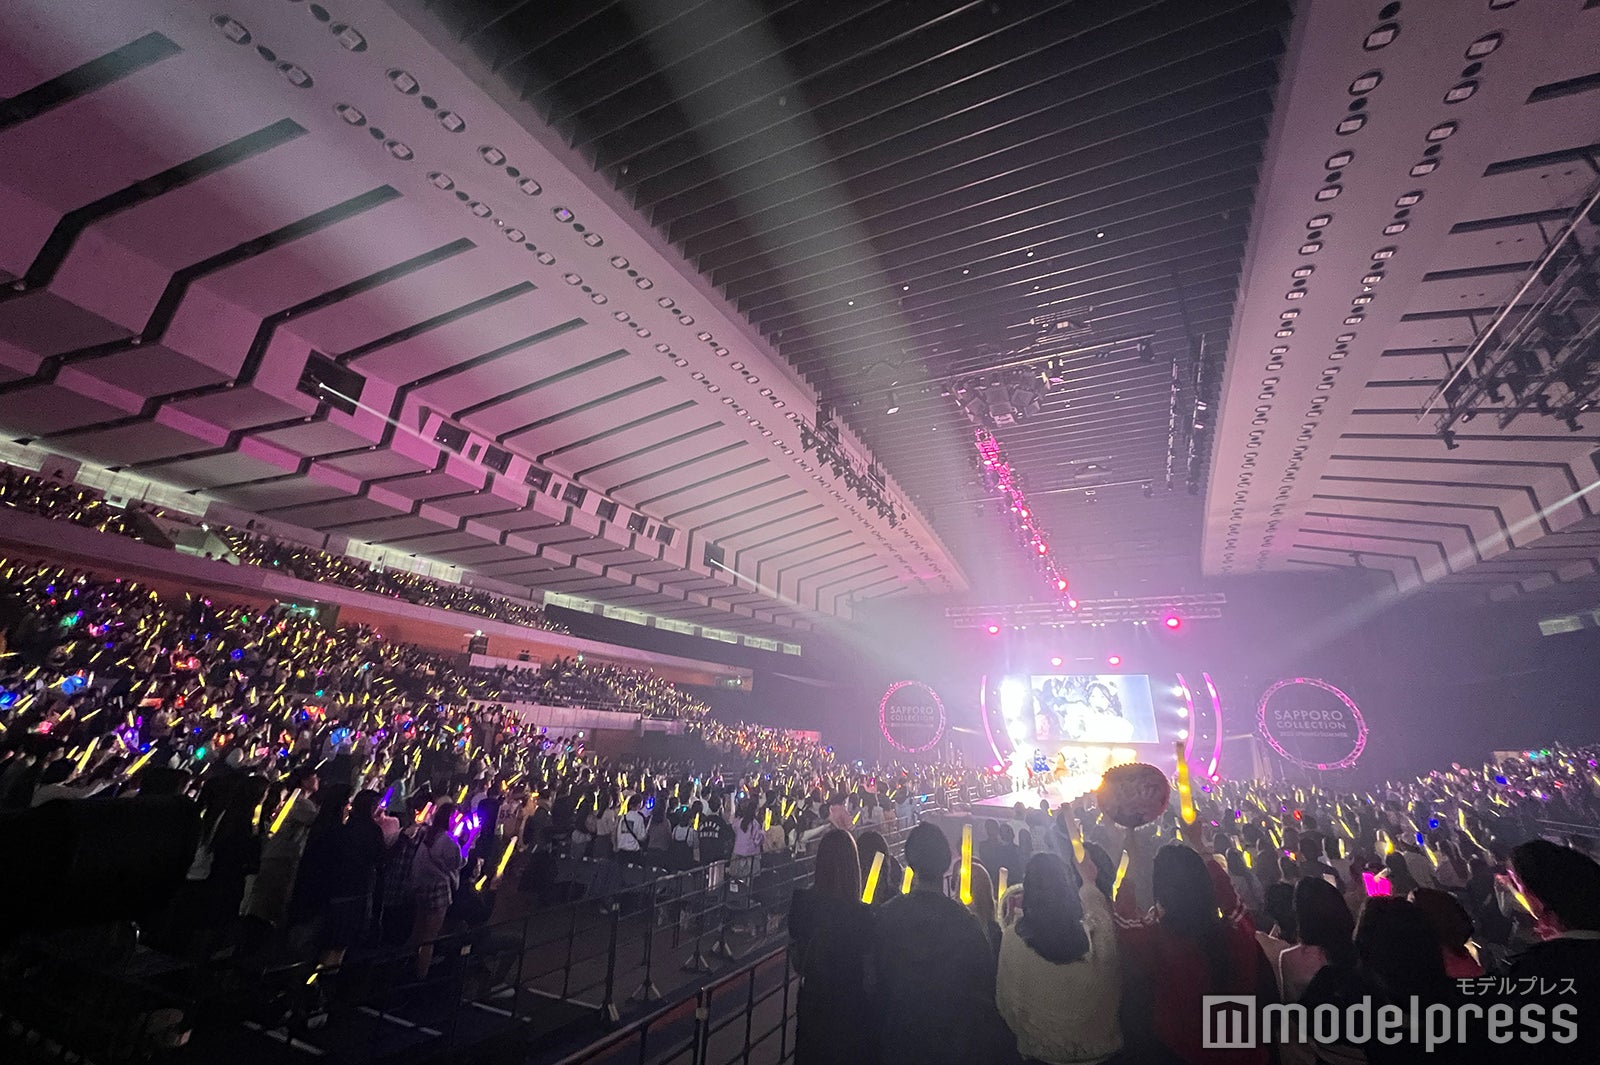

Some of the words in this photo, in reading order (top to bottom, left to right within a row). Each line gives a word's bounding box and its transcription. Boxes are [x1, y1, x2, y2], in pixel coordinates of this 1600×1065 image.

[890, 706, 934, 715] SAPPORO
[1274, 710, 1343, 721] SAPPORO
[1276, 721, 1346, 729] COLLECTION
